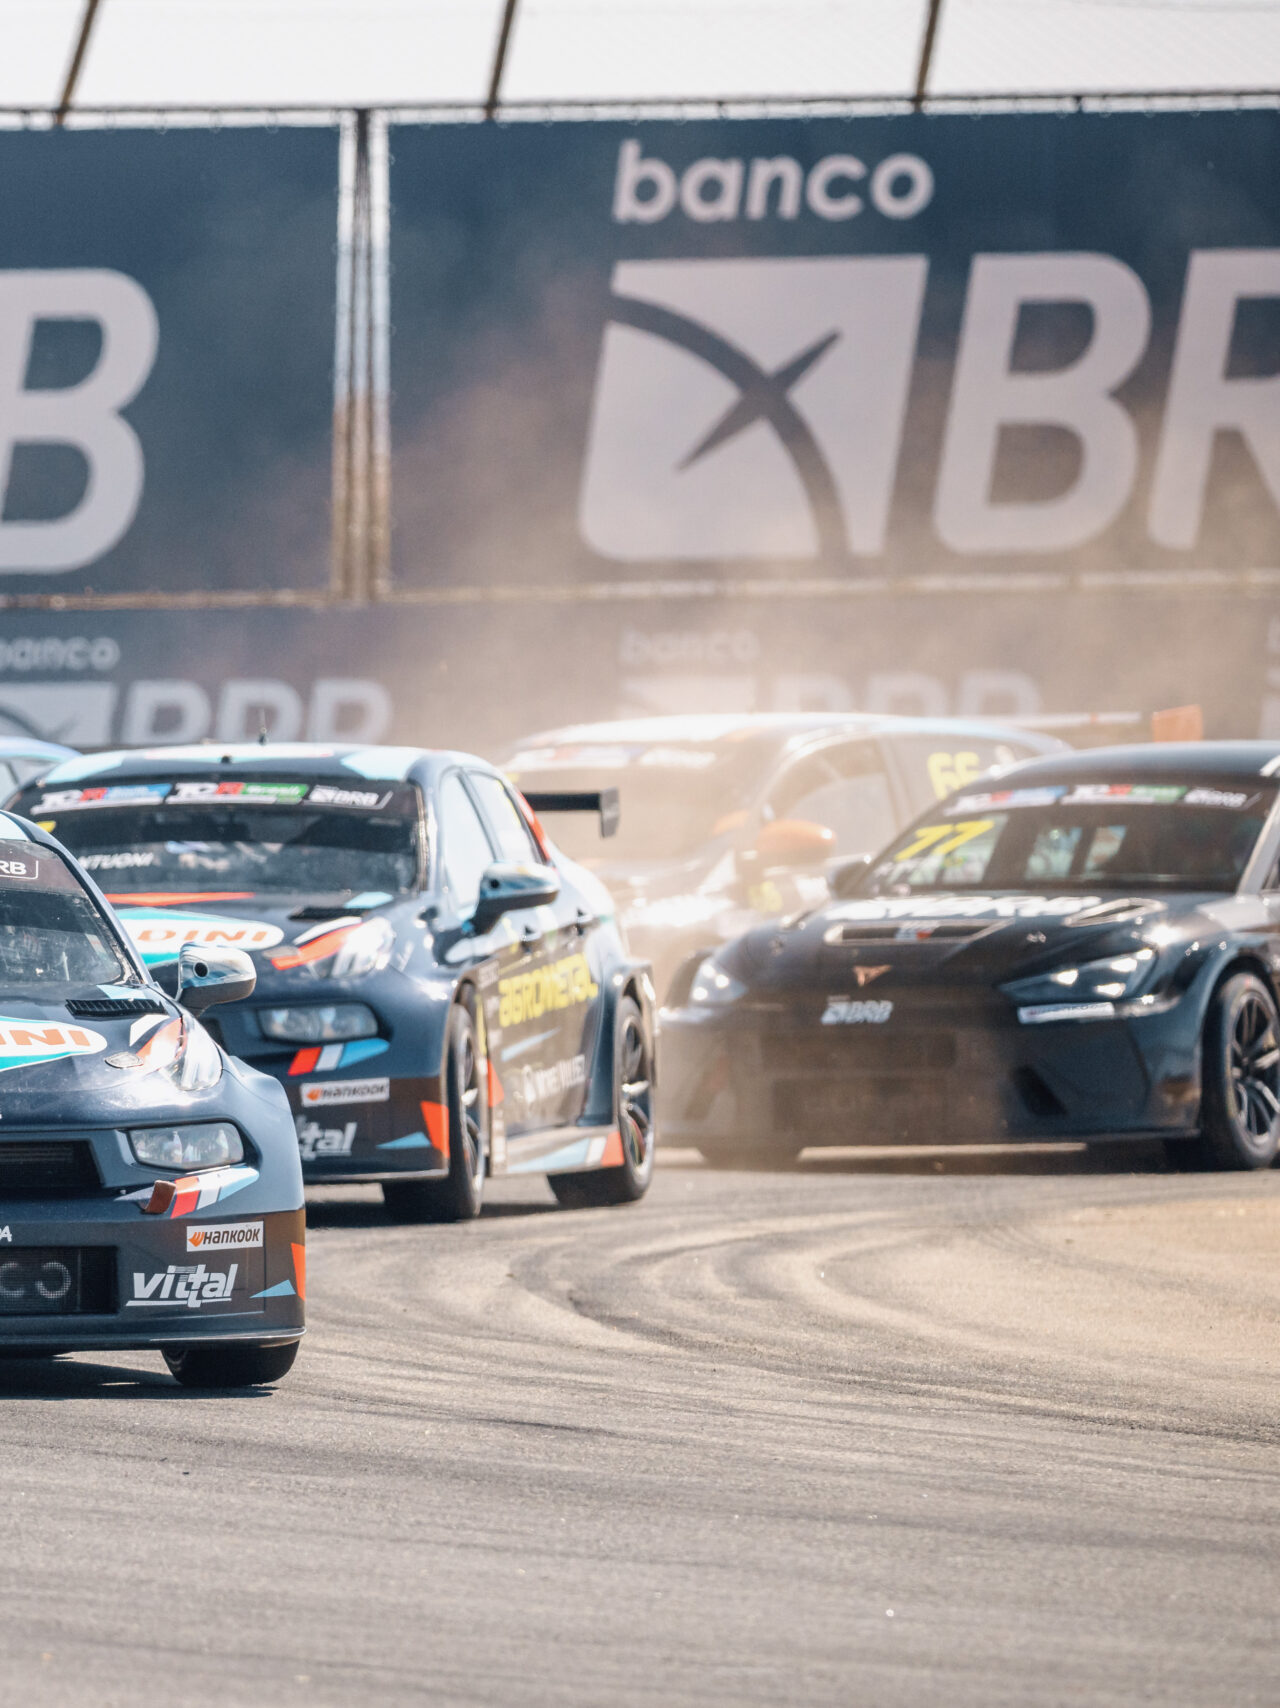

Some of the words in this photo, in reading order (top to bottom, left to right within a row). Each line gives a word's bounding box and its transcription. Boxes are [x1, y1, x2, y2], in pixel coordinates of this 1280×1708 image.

[612, 138, 934, 223] banco
[894, 820, 995, 861] 77
[137, 929, 268, 942] DINI
